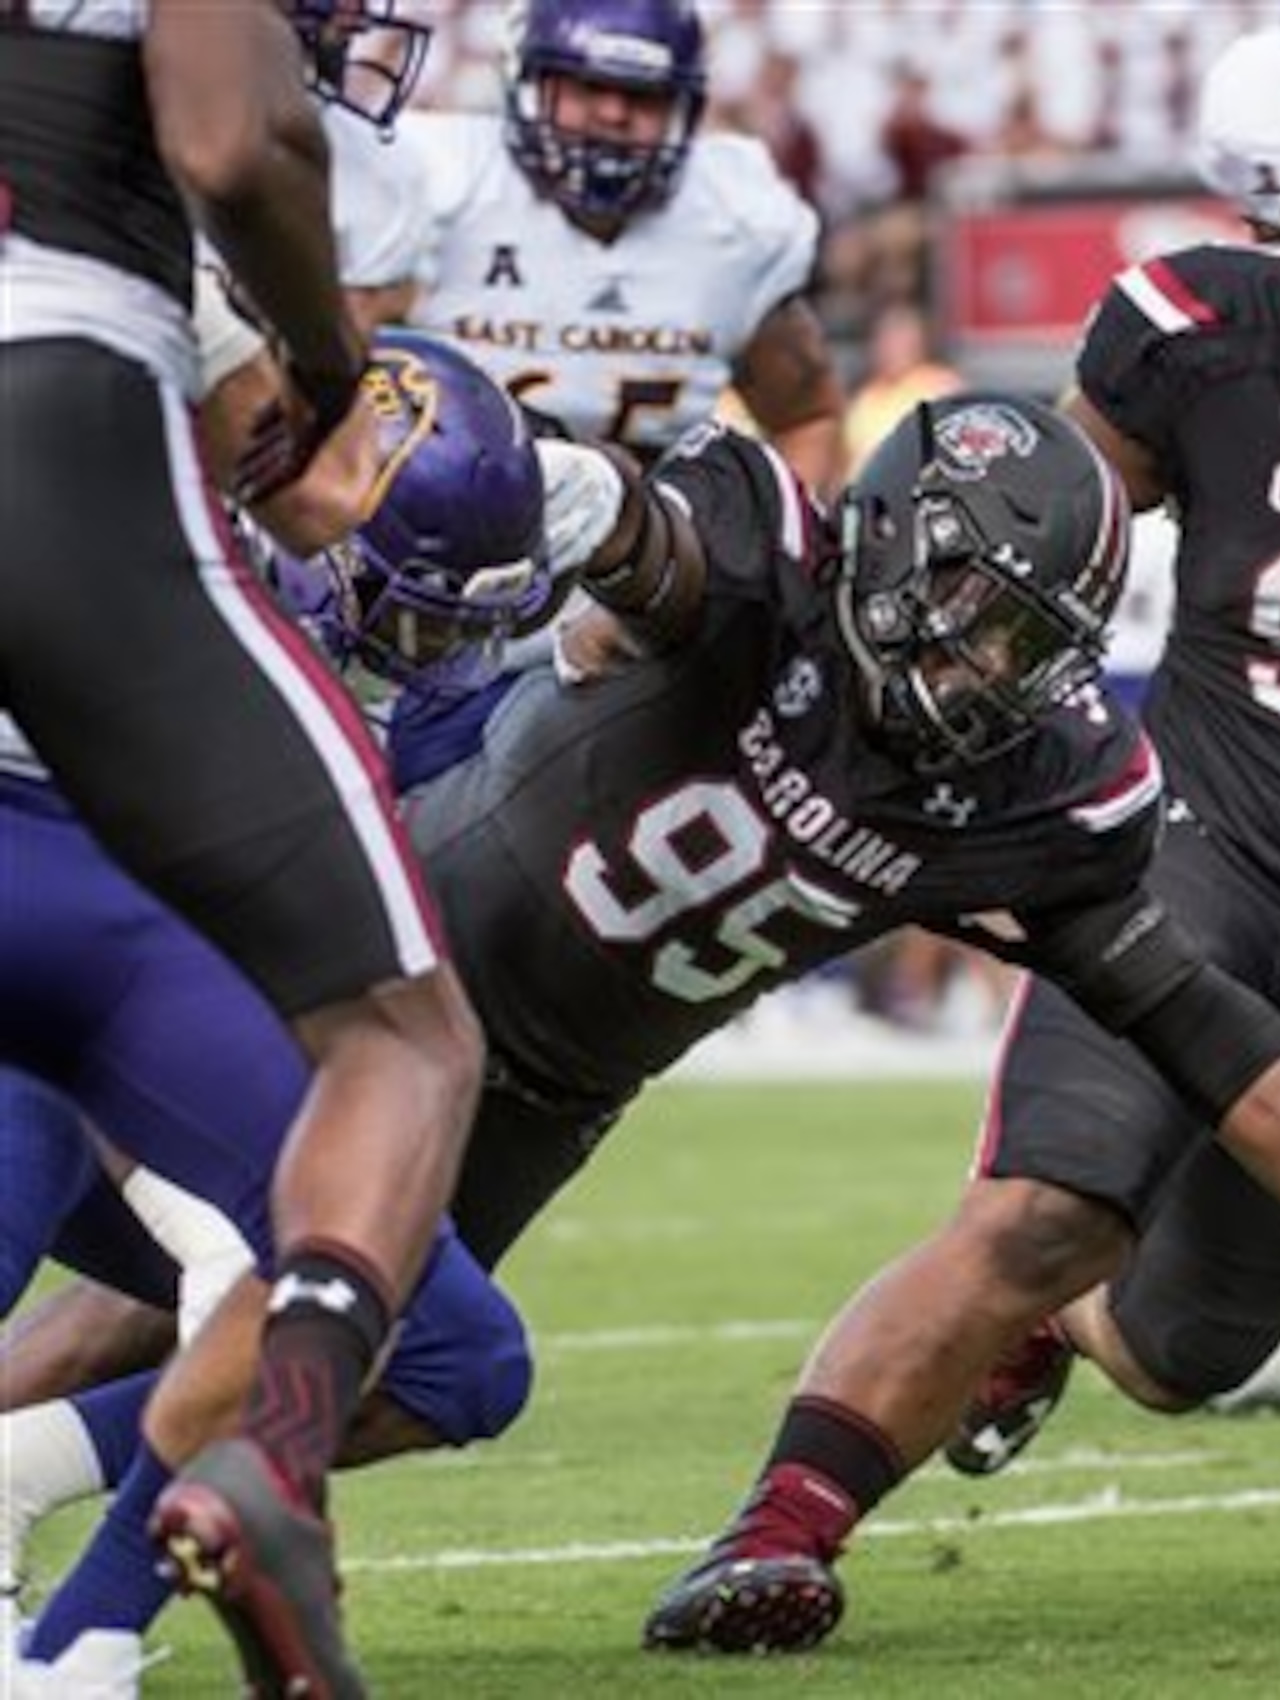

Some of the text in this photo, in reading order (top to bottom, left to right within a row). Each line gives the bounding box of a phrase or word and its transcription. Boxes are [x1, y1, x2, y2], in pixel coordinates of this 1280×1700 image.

[453, 315, 543, 352] EAST
[561, 775, 862, 1004] 95
[737, 706, 923, 897] CAROLINA
